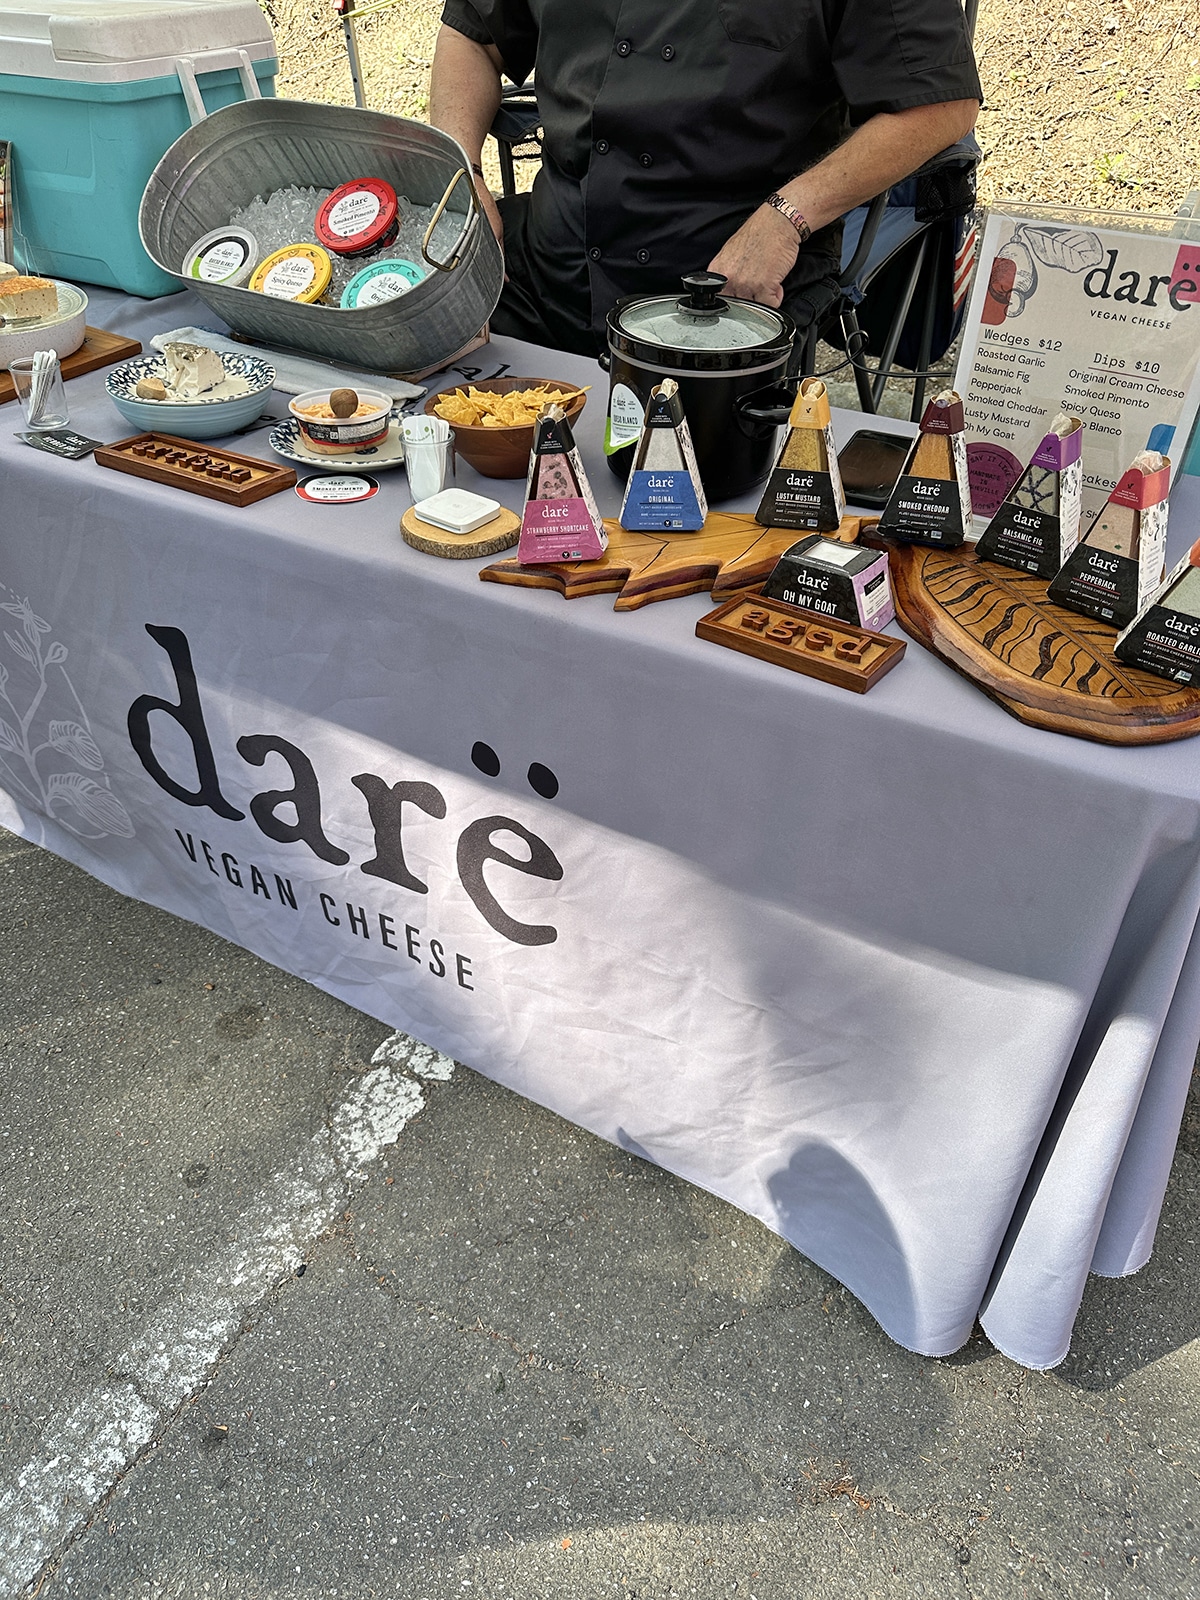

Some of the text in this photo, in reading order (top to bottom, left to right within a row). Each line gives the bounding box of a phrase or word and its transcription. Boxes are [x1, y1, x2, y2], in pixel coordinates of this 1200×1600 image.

[333, 209, 376, 226] Smoked Pimento
[271, 276, 303, 287] Spicy Queso
[1090, 310, 1172, 330] VEGAN CHEESE
[984, 328, 1063, 352] Wedges $12
[977, 347, 1046, 368] Roasted Garlic
[1093, 352, 1161, 375] Dips $10
[973, 362, 1031, 384] Balsamic Fig
[970, 377, 1023, 395] Pepperjack
[1068, 369, 1185, 399] Original Cream Cheese
[967, 392, 1048, 416] Smoked Cheddar
[1064, 384, 1150, 409] Smoked Pimento
[964, 407, 1030, 428] Lusty Mustard
[1060, 400, 1121, 420] Spicy Queso
[976, 424, 990, 436] My
[992, 428, 1016, 440] Goat
[1089, 421, 1122, 436] Blanco
[131, 441, 252, 484] artisan
[647, 475, 674, 488] darë
[786, 473, 814, 487] darë
[912, 481, 941, 496] darë
[1082, 474, 1117, 489] cakes
[648, 495, 674, 503] ORIGINAL
[776, 492, 821, 503] LUSTY MUSTARD
[898, 500, 950, 514] SMOKED CHEDDAR
[541, 504, 569, 518] darë
[1013, 510, 1042, 529] darë
[526, 524, 589, 535] STRAWBERRY SHORTCAKE
[1002, 527, 1032, 543] BALSAMIC
[1033, 536, 1044, 546] FIG
[1088, 552, 1119, 573] darë
[797, 570, 830, 591] darë
[1079, 571, 1117, 591] PEPPERJACK
[783, 589, 796, 603] OH
[798, 593, 812, 608] MY
[814, 598, 838, 615] GOAT
[1164, 615, 1200, 636] darë
[741, 610, 873, 664] aged
[1146, 631, 1178, 648] ROASTED
[1178, 641, 1200, 656] GARLI
[127, 622, 564, 947] darë
[174, 828, 475, 992] VEGAN CHEESE
